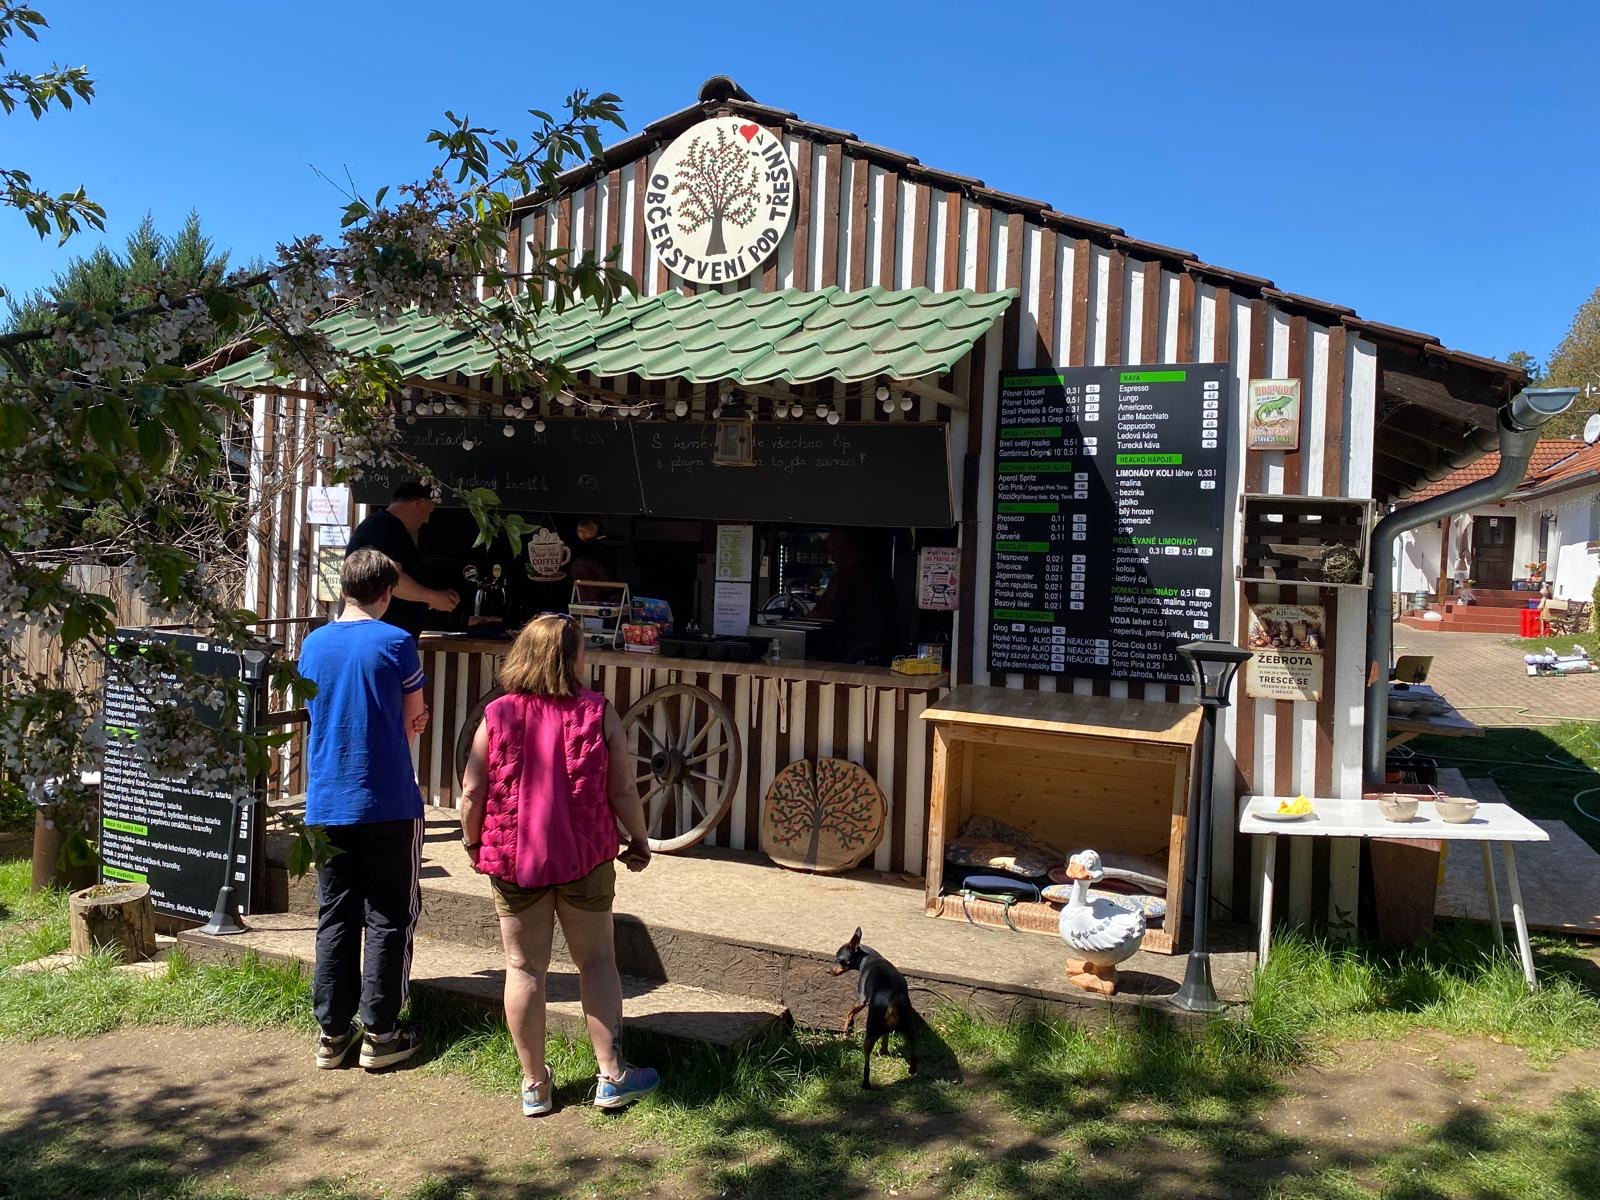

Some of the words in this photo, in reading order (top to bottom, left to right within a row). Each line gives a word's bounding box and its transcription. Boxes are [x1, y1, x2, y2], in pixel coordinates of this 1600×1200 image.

[751, 140, 790, 221] TŘEŠNÍ
[646, 174, 746, 282] OBČERSTVENÍ
[748, 228, 779, 264] POD
[1120, 384, 1149, 393] Espresso
[1118, 394, 1139, 402] Lungo
[1136, 412, 1168, 420] Macchiato
[1118, 422, 1156, 431] Cappuccino
[1117, 441, 1142, 449] Turecká
[1144, 441, 1160, 449] káva
[1116, 468, 1154, 477] LIMONÁDY
[1198, 469, 1212, 477] 0,33
[1118, 498, 1138, 506] jablko
[1158, 536, 1198, 545] LIMONÁDY
[1182, 548, 1192, 556] 0,5
[533, 558, 559, 566] COFFEE
[1140, 586, 1178, 596] LIMONÁDY
[1110, 616, 1130, 624] VODA
[993, 624, 1008, 632] Grog
[1012, 635, 1026, 643] Yuzu
[1067, 638, 1095, 646] NEALKO
[1112, 640, 1129, 648] Coca
[1130, 641, 1146, 649] Cola
[1032, 644, 1050, 652] ALKO
[1067, 646, 1096, 655] NEALKO
[1130, 650, 1145, 658] Cola
[1031, 652, 1050, 660] ALKO
[1066, 655, 1094, 664] NEALKO
[1258, 653, 1312, 666] ŽEBROTA
